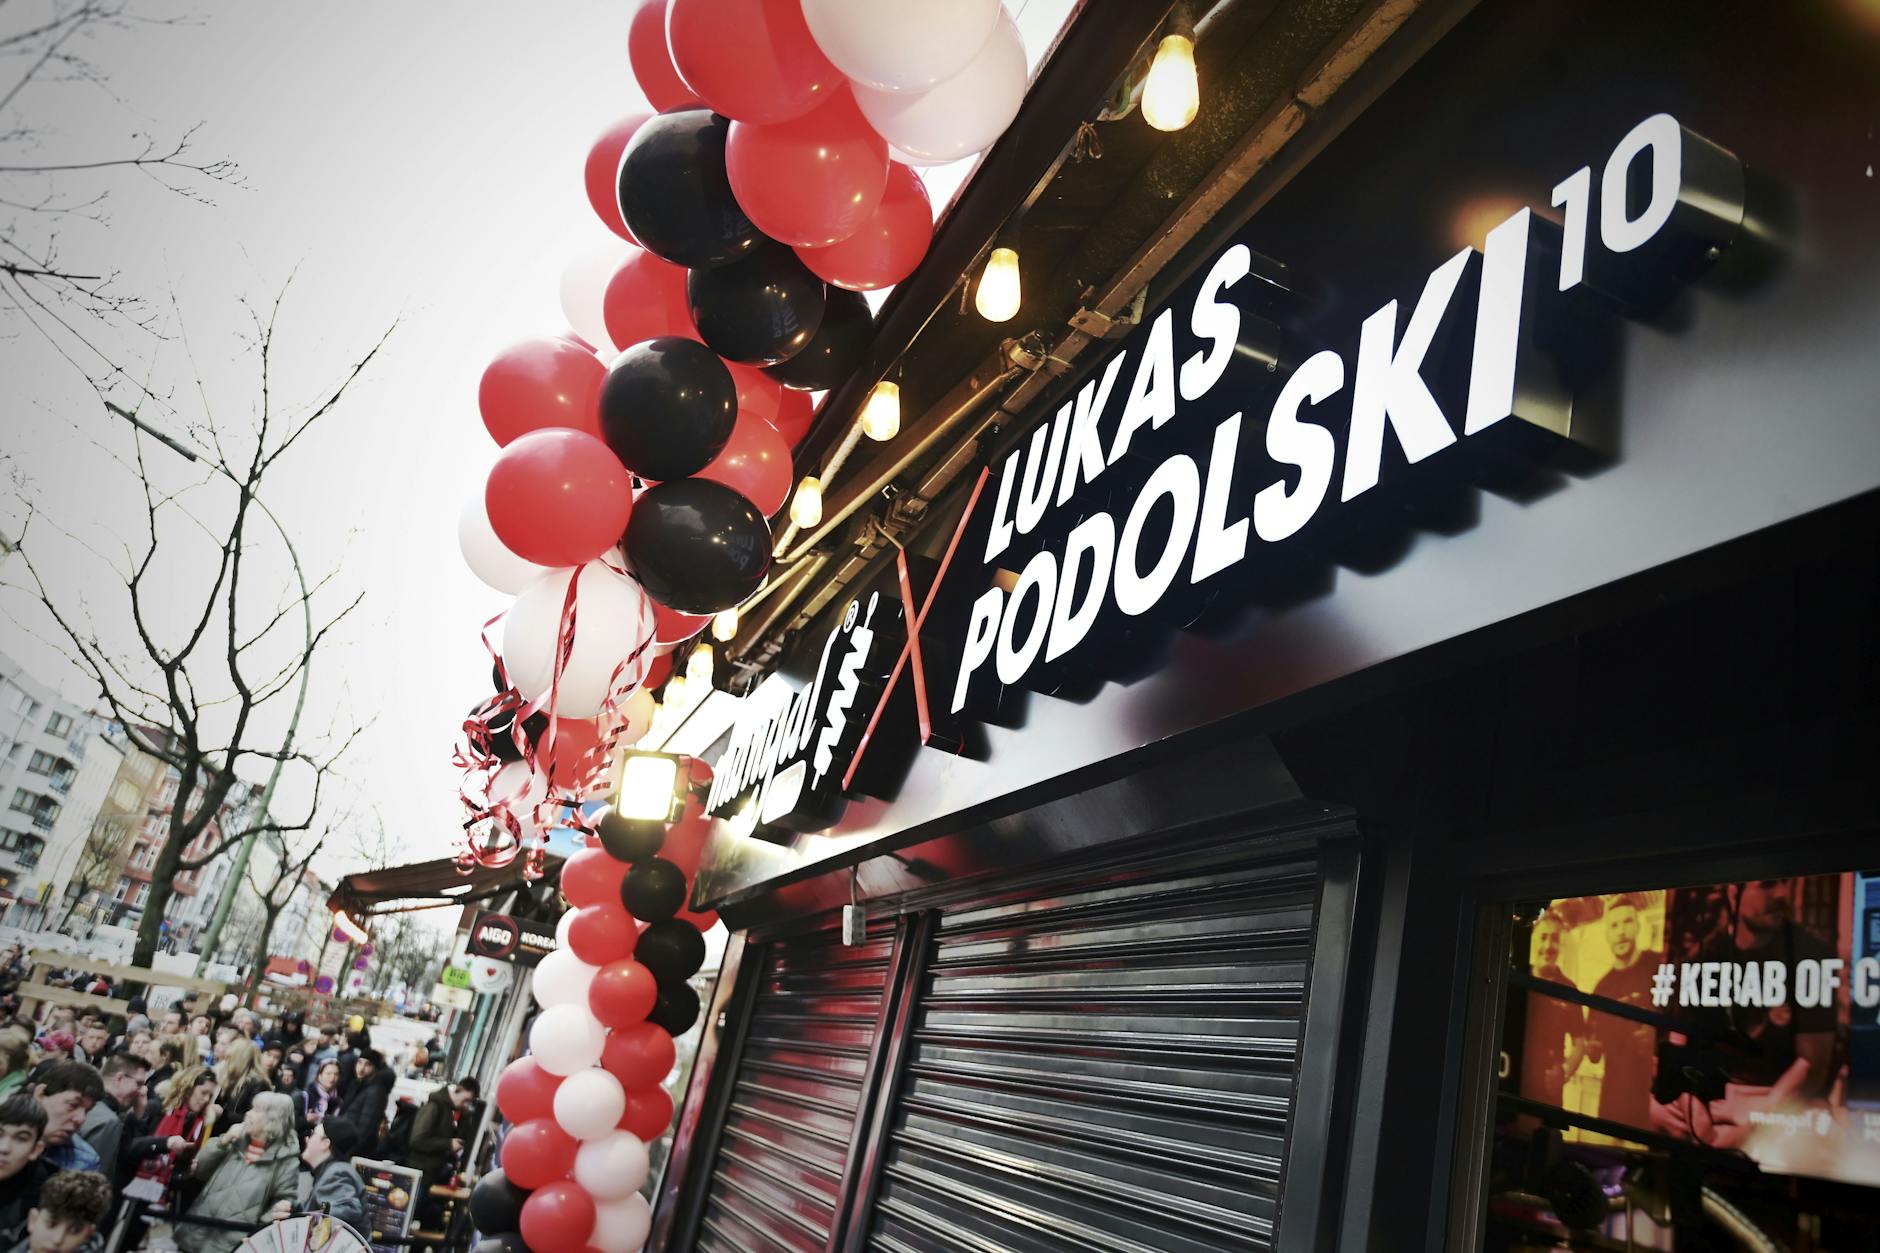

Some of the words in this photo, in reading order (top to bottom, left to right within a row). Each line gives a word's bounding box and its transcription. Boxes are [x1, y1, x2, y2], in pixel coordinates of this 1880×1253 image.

[951, 206, 1530, 714] PODOLSKI
[1551, 113, 1682, 292] 10
[984, 243, 1250, 563] LUKAS
[1795, 958, 1844, 1008] OF
